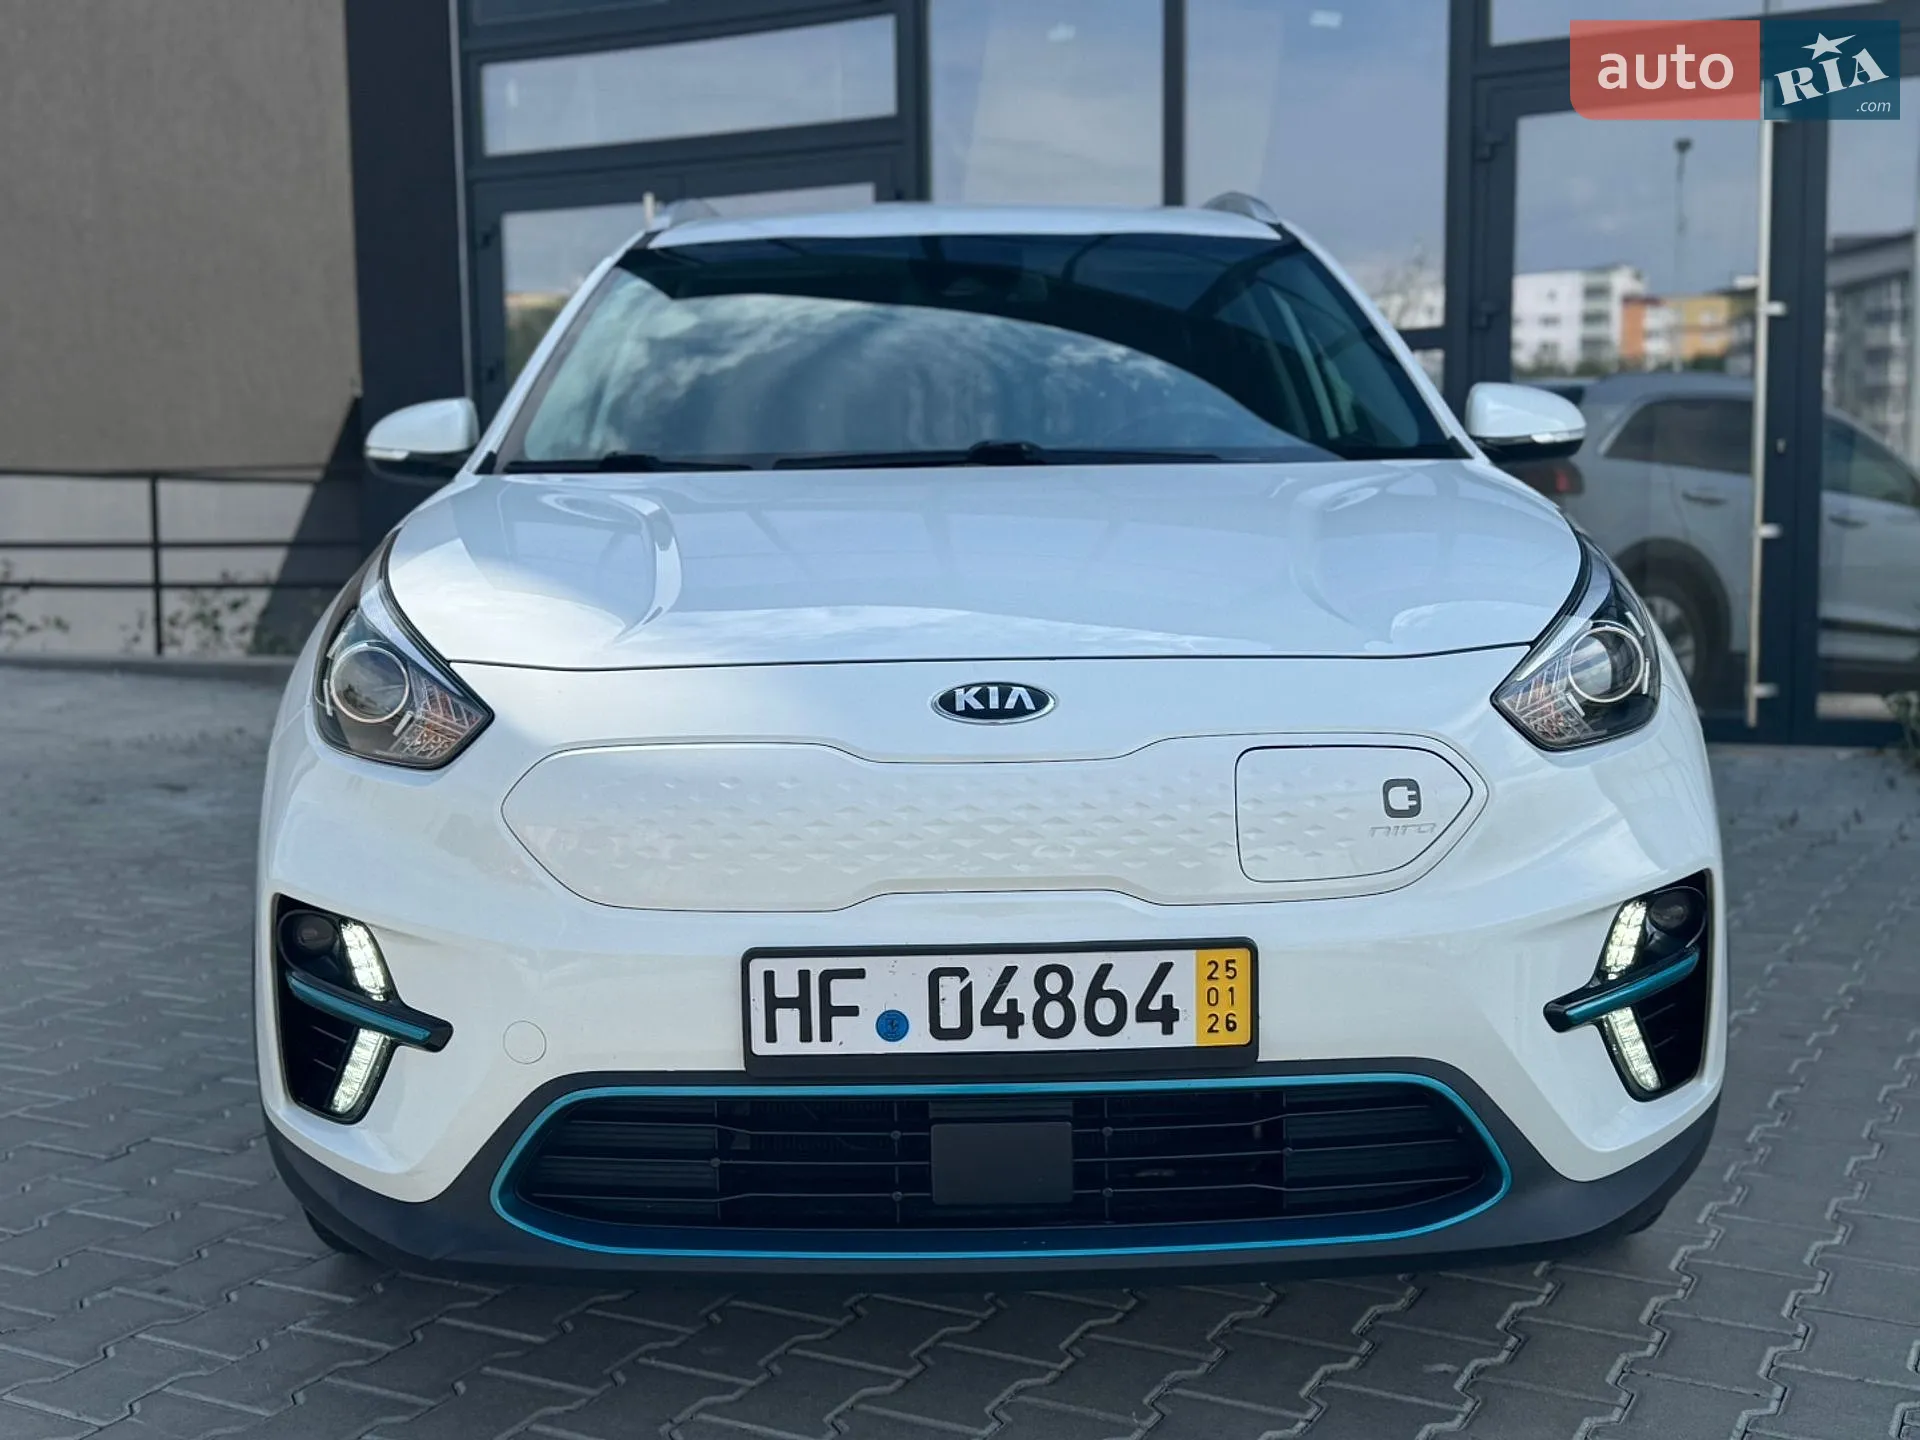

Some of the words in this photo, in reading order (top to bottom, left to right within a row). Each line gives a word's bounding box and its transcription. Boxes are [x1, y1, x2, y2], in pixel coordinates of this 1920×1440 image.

[954, 686, 1036, 712] KIA
[1206, 959, 1238, 981] 25
[763, 968, 866, 1043] HF
[928, 961, 1180, 1040] 04864
[1206, 986, 1236, 1007] 01
[1206, 1012, 1238, 1034] 26
